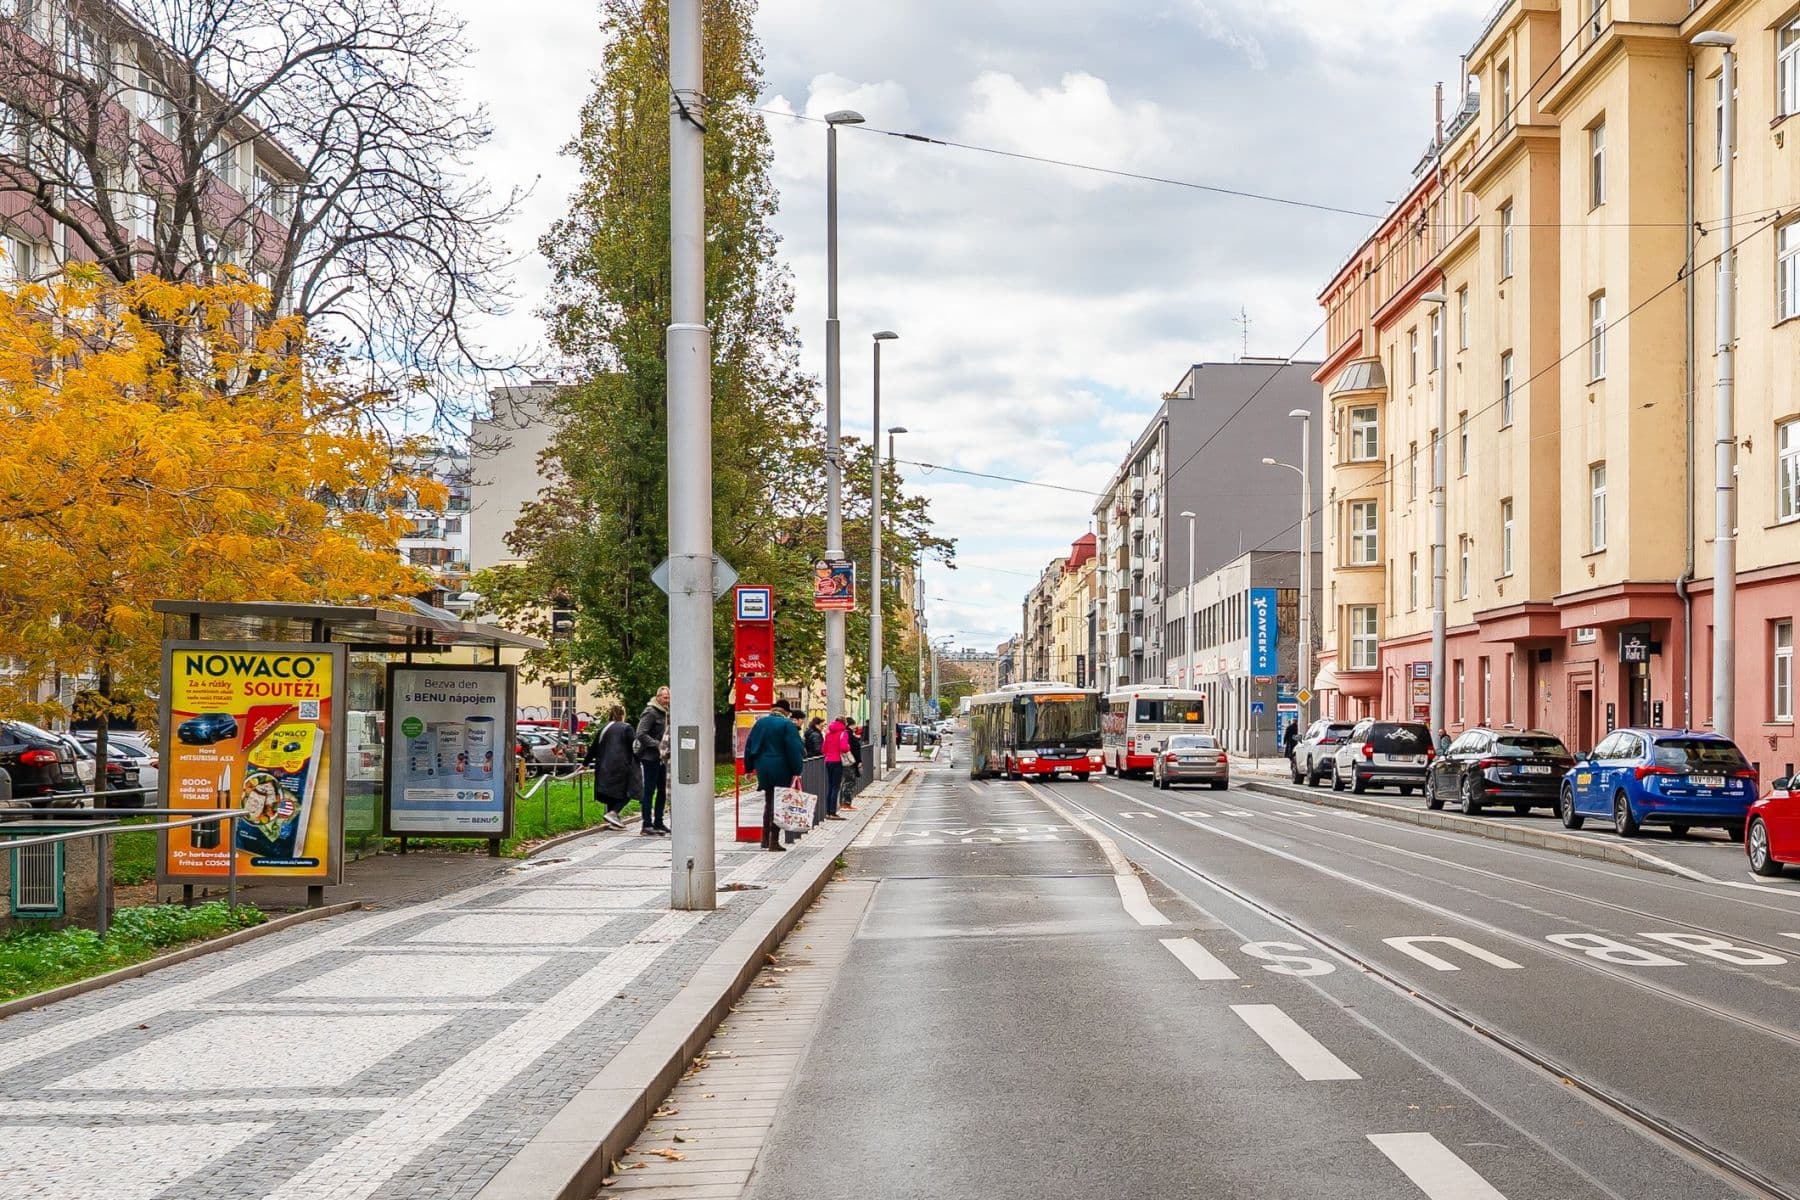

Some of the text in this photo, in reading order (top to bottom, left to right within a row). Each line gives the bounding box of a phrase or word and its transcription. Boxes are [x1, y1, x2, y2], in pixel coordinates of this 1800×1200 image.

[186, 654, 316, 679] NOWACO
[244, 679, 321, 698] SOUTĚŽ!
[424, 679, 478, 689] Bezva den
[405, 692, 496, 705] s BENU nápojem
